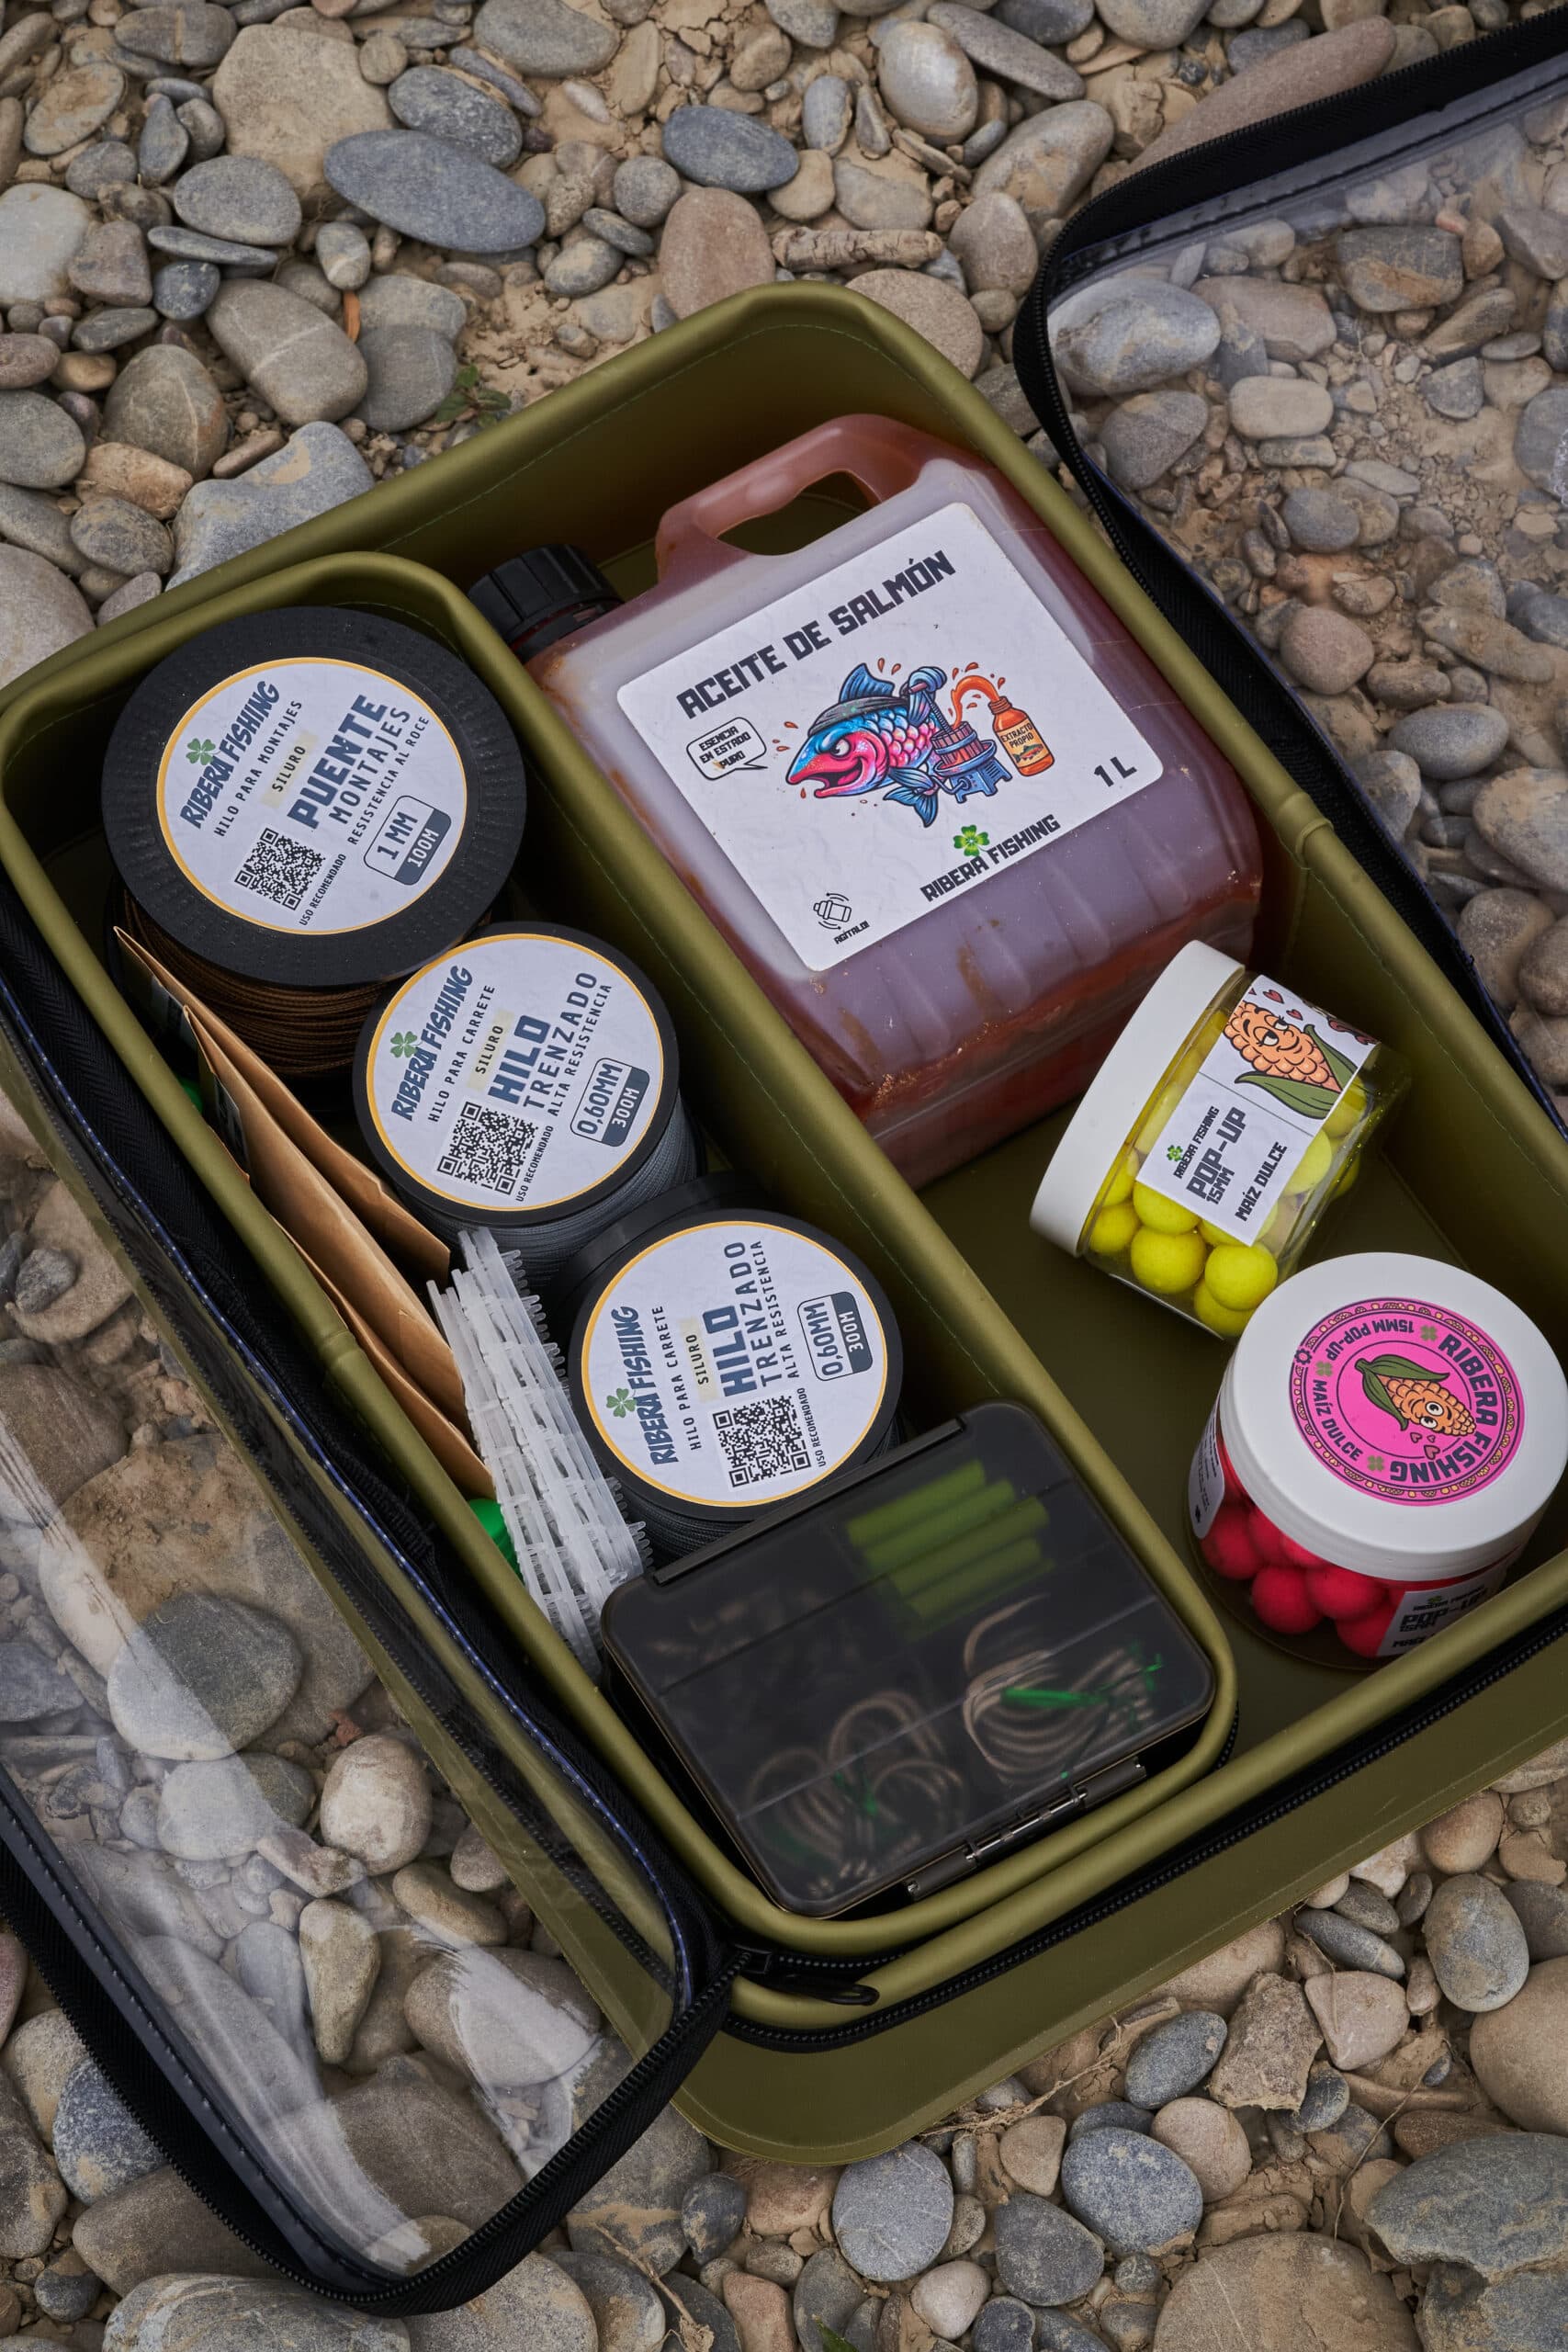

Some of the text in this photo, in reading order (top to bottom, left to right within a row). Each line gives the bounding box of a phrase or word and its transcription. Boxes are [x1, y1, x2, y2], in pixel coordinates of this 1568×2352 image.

[676, 549, 956, 720] ACEITE DE SALMÓN
[180, 681, 280, 829] RIBERA FISHING
[214, 699, 302, 836] HILO PARA MONTAJES
[271, 745, 306, 793] SILURO
[287, 694, 389, 829] PUENTE
[329, 707, 412, 824] MONTAJES
[699, 731, 751, 763] EN ESTADO
[1000, 722, 1033, 742] EXTRACTO
[1009, 732, 1034, 749] PROPIO
[1093, 756, 1137, 787] 1 L
[347, 716, 430, 845] RESISTENCIA AL ROCE
[378, 812, 419, 861] 1 MM
[408, 828, 440, 868] 100M
[919, 814, 1061, 902] RIBERA FISHING
[299, 853, 347, 927] USO RECOMENDADO
[391, 965, 473, 1122] RIBERA FISHING
[427, 984, 496, 1123] HILO PARA CARRETE
[475, 1024, 504, 1075] SILURO
[488, 1014, 551, 1105] HILO
[522, 972, 598, 1111] TRENZADO
[547, 983, 612, 1116] ALTA RESISTENCIA
[576, 1063, 624, 1136] 0,60MM
[611, 1087, 640, 1129] 300M
[515, 1125, 554, 1203] USO RECOMENDADO
[1173, 1105, 1220, 1180] RIBERA FISHING
[1186, 1106, 1247, 1200] POP-UP
[1235, 1141, 1288, 1222] MAÍZ DULCE
[1206, 1166, 1235, 1205] 15MM
[723, 1241, 783, 1387] TRENZADO
[750, 1240, 800, 1379] ALTA RESISTENCIA
[804, 1301, 844, 1376] 0,60MM
[838, 1310, 864, 1352] 300M
[1325, 1318, 1415, 1362] 15MM POP-UP
[611, 1306, 679, 1465] RIBERA FISHING
[652, 1306, 702, 1451] HILO PARA CARRETE
[684, 1333, 709, 1385] SILURO
[702, 1306, 758, 1397] HILO
[796, 1386, 826, 1467] USO RECOMENDADO
[1313, 1379, 1364, 1462] MAÍZ DULCE
[1390, 1334, 1498, 1484] RIBERA FISHING
